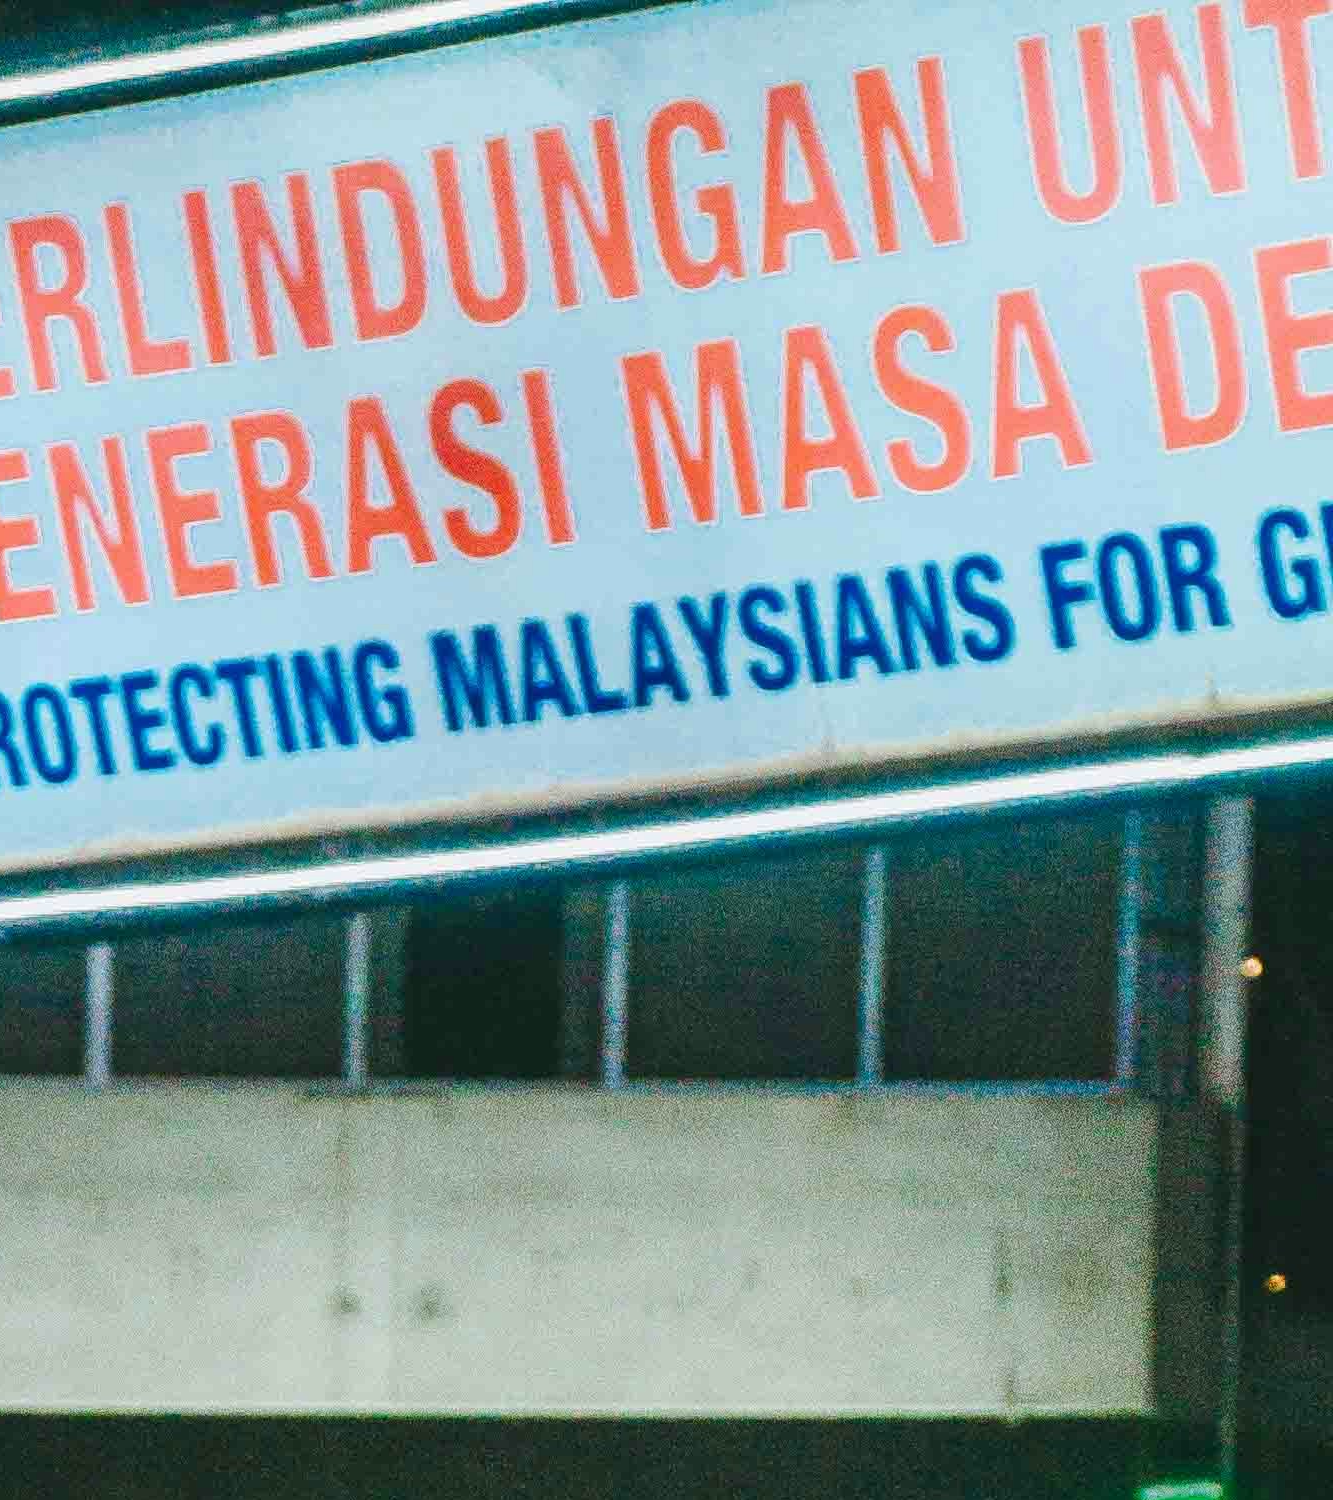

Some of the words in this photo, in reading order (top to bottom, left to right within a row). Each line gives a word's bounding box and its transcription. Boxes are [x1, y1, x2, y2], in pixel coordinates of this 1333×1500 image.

[1016, 0, 1333, 223] UNT
[619, 290, 1093, 532] MASA
[1138, 237, 1333, 453] DE
[431, 552, 1017, 734] MALAYSIANS
[1039, 523, 1233, 653] FOR
[1254, 501, 1333, 622] G
